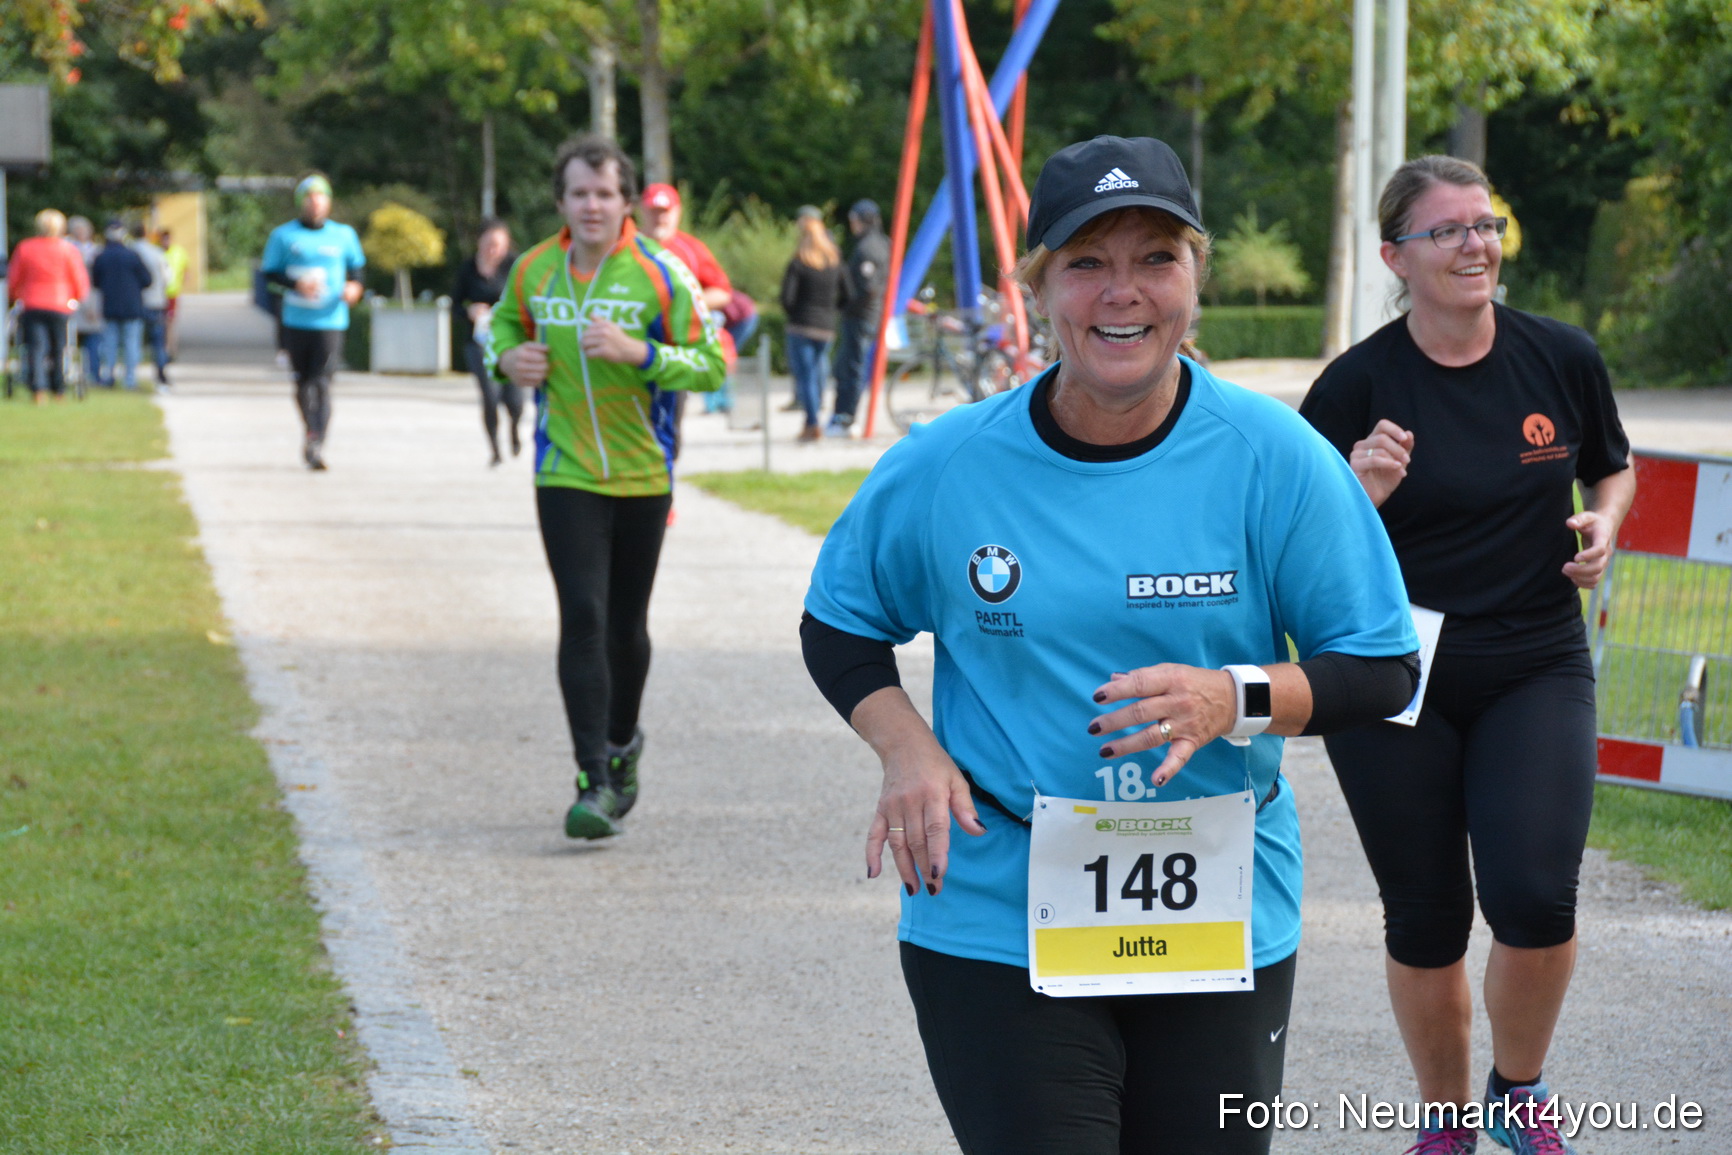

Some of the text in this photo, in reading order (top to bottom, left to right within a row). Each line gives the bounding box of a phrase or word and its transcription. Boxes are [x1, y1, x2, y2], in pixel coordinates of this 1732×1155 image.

[1094, 179, 1140, 193] adidas
[530, 296, 646, 329] BOCK
[971, 546, 1016, 567] BMW
[1127, 571, 1238, 599] BOCK
[1126, 596, 1239, 609] inspired by smart concepts
[975, 610, 1023, 627] PARTL
[978, 624, 1025, 638] Neumarkt
[1094, 761, 1157, 802] 18.
[1118, 817, 1192, 832] BOCK
[1084, 852, 1198, 913] 148
[1040, 908, 1049, 920] D
[1112, 936, 1168, 958] Jutta
